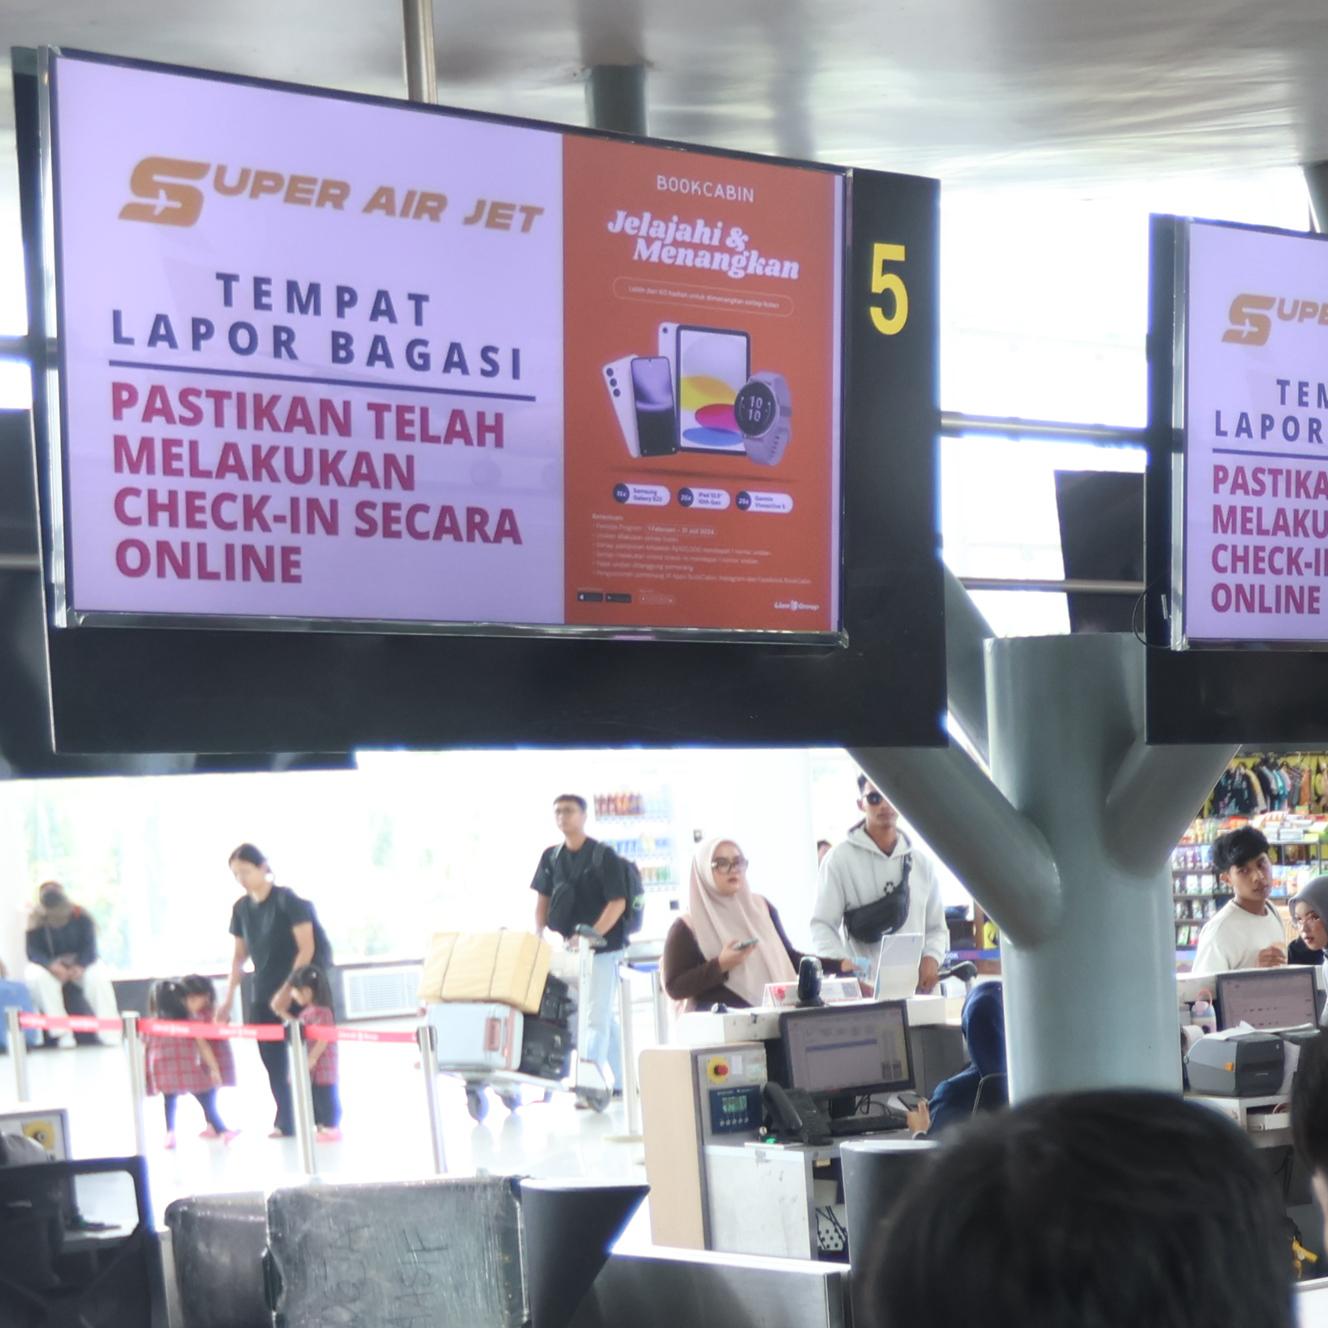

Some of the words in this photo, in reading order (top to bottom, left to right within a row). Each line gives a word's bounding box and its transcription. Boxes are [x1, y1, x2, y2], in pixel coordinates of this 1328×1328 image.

[118, 153, 350, 229] SUPER
[364, 186, 448, 224] AIR
[463, 198, 545, 235] JET
[656, 175, 755, 203] BOOKCABIN
[607, 210, 723, 247] Jelajahi
[725, 226, 750, 251] &
[632, 238, 800, 280] Menangkan
[215, 272, 432, 328] TEMPAT
[869, 243, 910, 337] 5
[111, 309, 300, 363] LAPOR
[331, 331, 523, 382] BAGASI
[110, 381, 354, 438] PASTIKAN
[368, 399, 506, 449] TELAH
[1214, 409, 1324, 445] LAPOR
[112, 434, 416, 492] MELAKUKAN
[114, 485, 342, 540] CHECK-IN
[354, 499, 524, 546] SECARA
[115, 537, 303, 586] ONLINE
[1211, 582, 1321, 616] ONLINE
